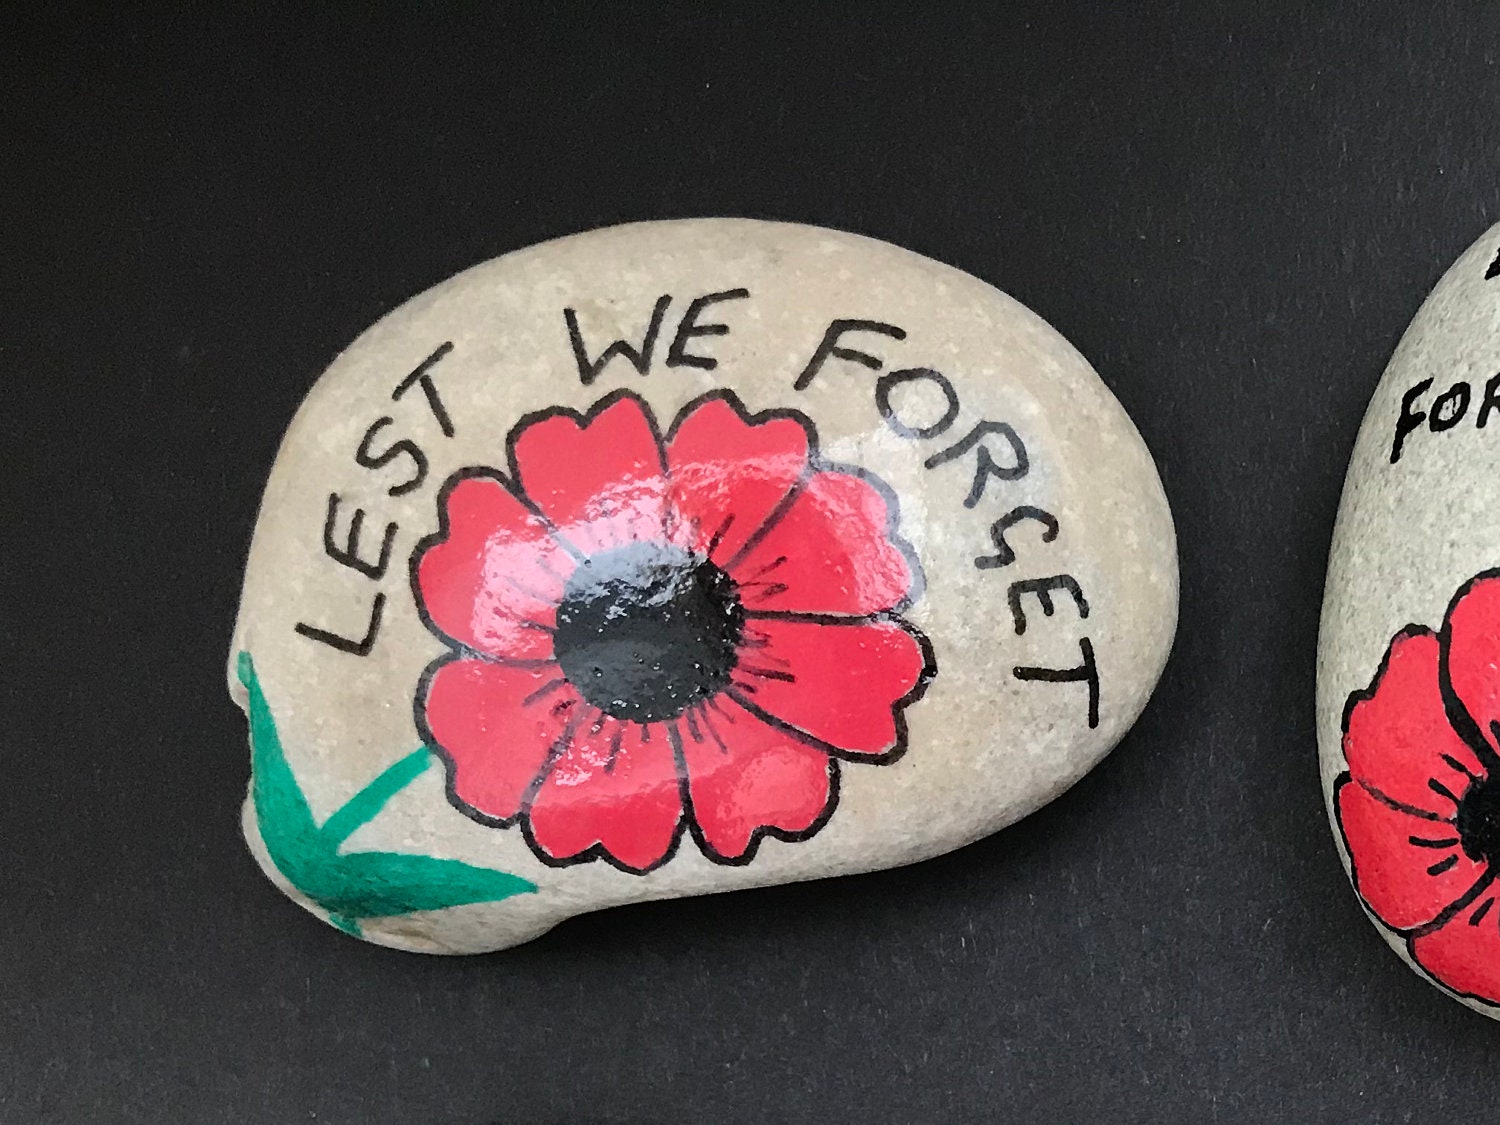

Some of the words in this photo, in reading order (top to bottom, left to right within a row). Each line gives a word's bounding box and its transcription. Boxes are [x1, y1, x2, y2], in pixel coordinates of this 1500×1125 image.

[295, 340, 455, 657] LEST
[564, 287, 750, 387] WE
[794, 318, 1101, 730] FORGET
